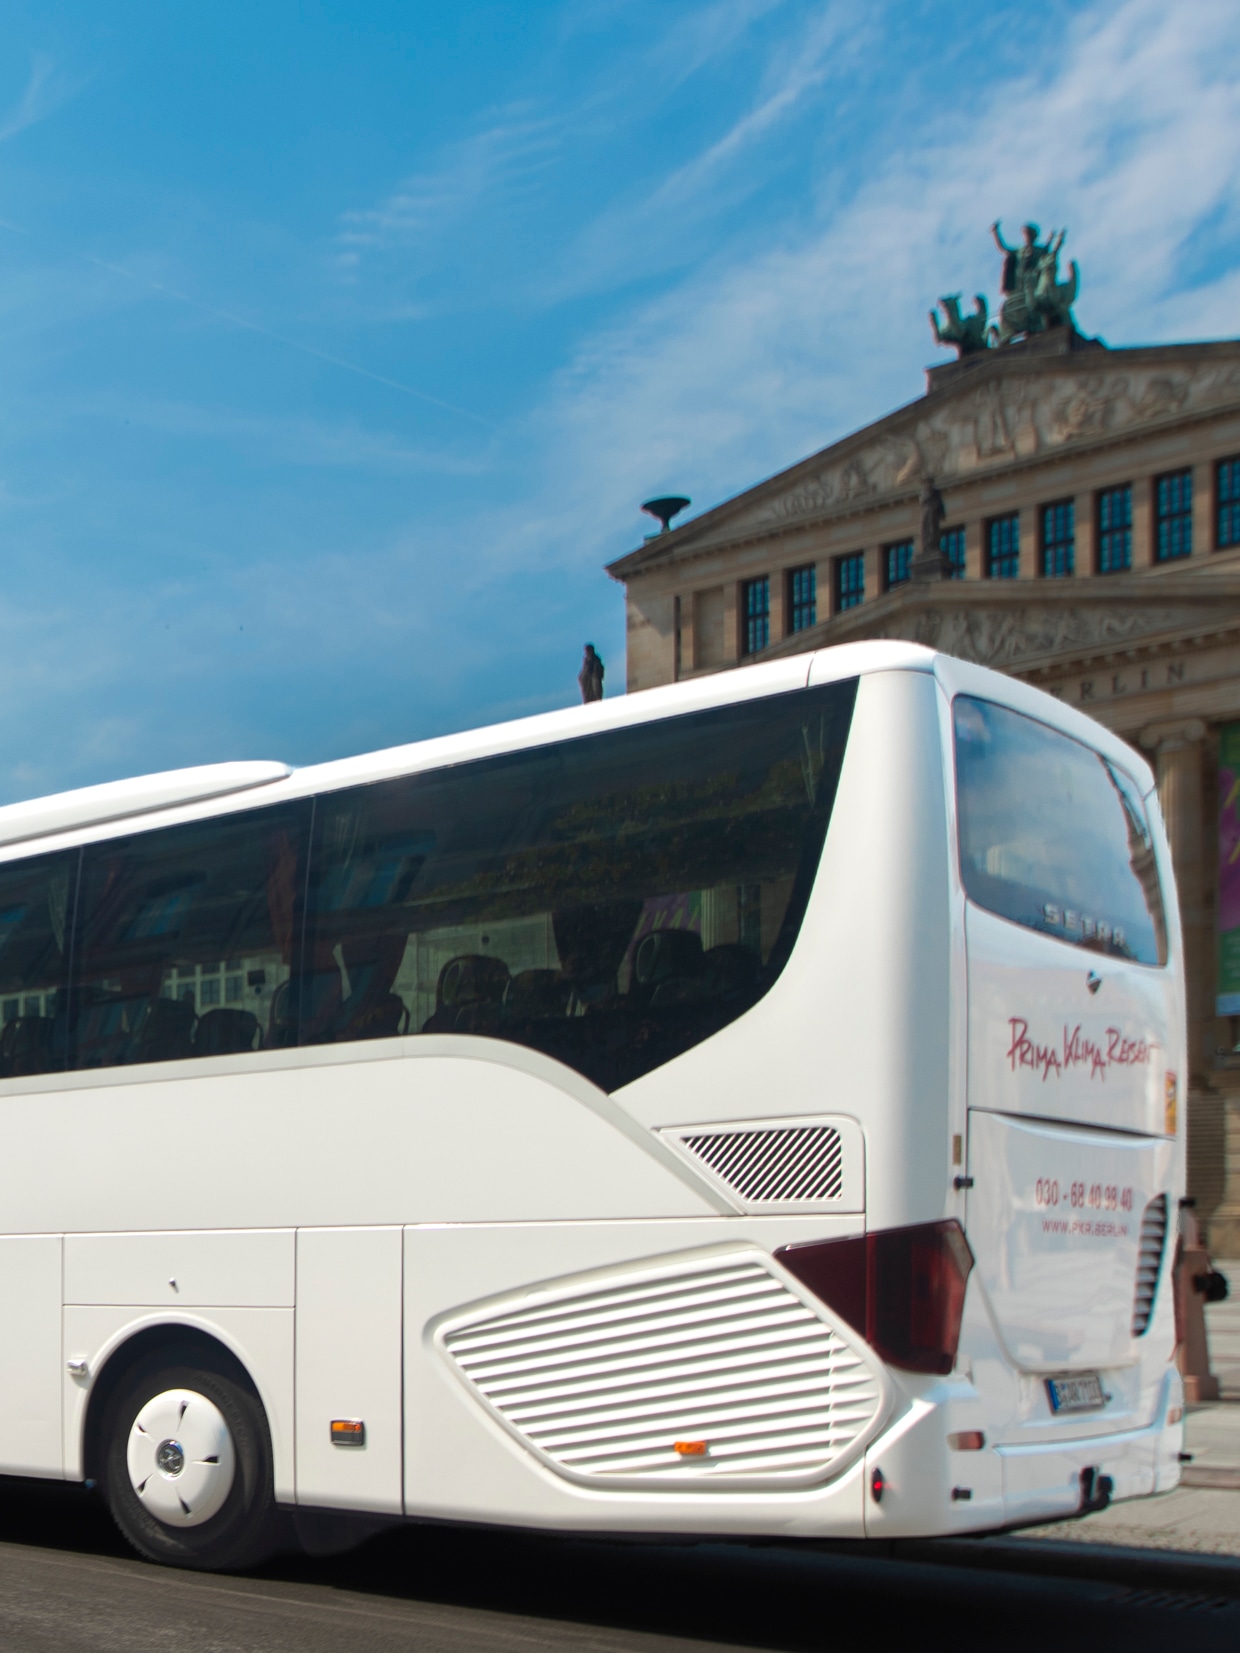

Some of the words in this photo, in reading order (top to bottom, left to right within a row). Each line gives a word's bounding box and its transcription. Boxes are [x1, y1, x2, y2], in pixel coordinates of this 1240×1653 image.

[1048, 662, 1186, 701] ERLIN
[1042, 903, 1126, 948] SETRA
[1035, 1177, 1059, 1207] 030
[1070, 1181, 1085, 1209] 68
[1087, 1182, 1102, 1211] 40
[1120, 1186, 1133, 1213] 40
